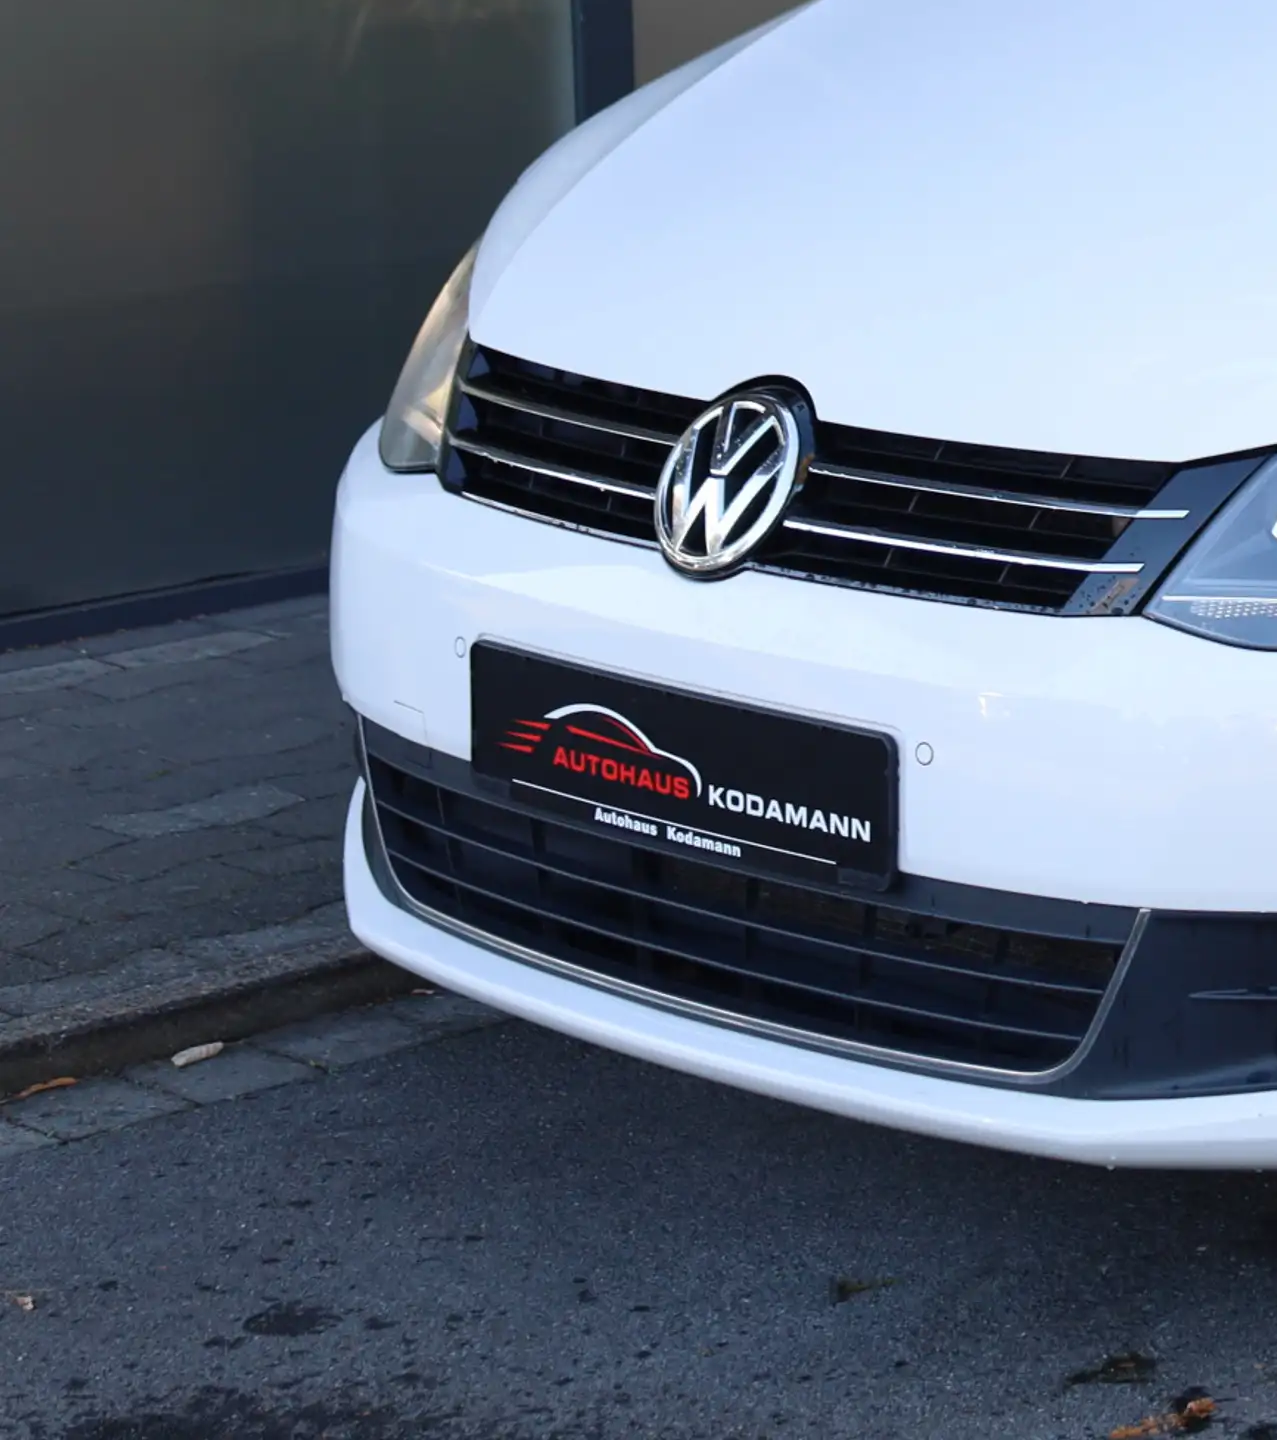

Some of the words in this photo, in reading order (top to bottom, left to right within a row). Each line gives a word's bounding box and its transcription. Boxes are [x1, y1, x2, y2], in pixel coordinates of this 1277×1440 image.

[552, 746, 690, 800] AUTOHAUS
[708, 784, 872, 843] KODAMANN
[594, 807, 658, 837] Autohaus
[666, 825, 742, 858] Kodamann
